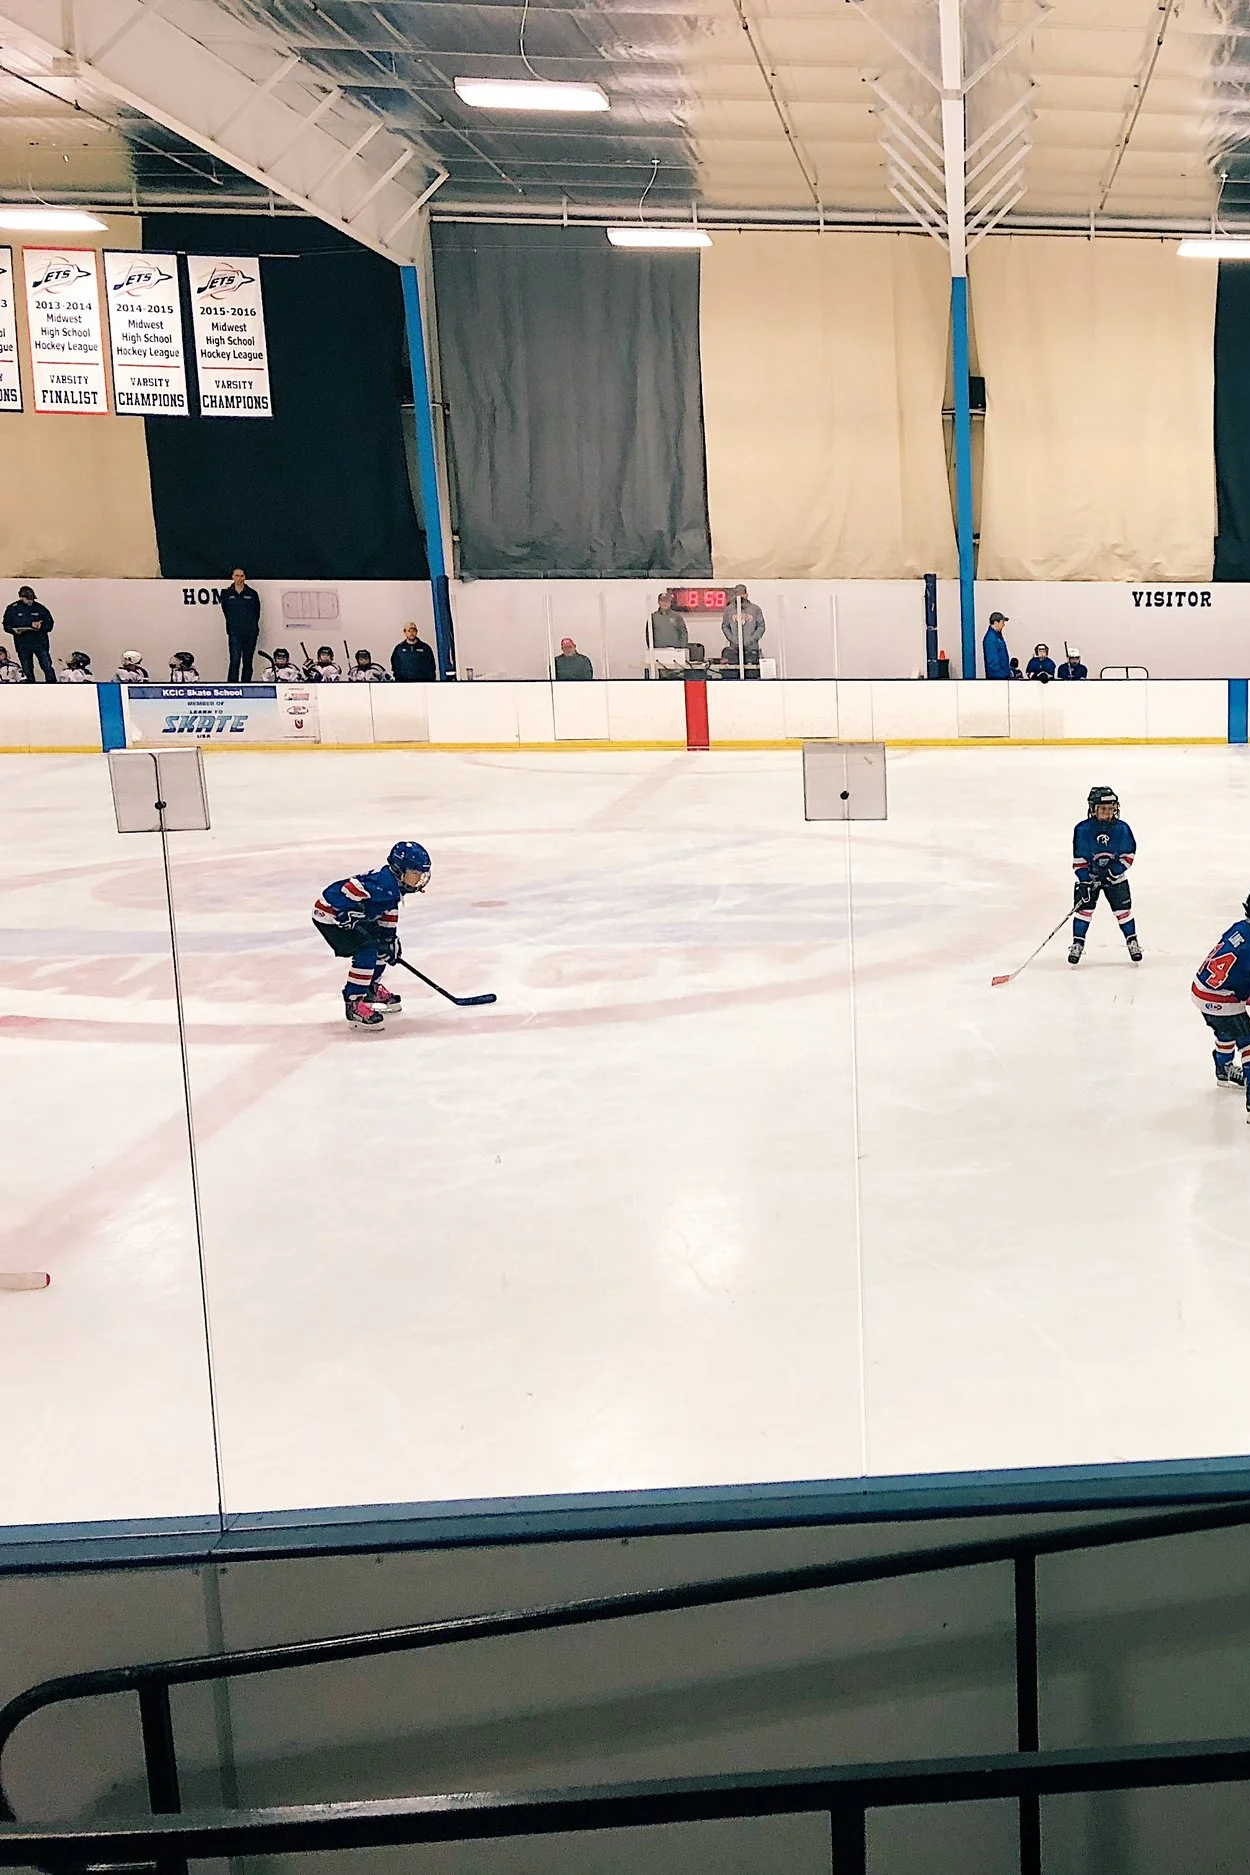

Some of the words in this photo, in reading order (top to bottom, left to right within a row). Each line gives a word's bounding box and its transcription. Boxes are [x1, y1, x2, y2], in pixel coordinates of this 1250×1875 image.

[35, 301, 92, 310] 2013-2014
[116, 304, 174, 314] 2014-2015
[200, 307, 257, 316] 2015-2016
[47, 313, 82, 323] Midwest
[128, 319, 164, 330] Midwest
[212, 322, 247, 332] Midwest
[41, 327, 60, 338] High
[62, 328, 91, 337] School
[122, 333, 142, 344] High
[144, 334, 172, 343] School
[206, 336, 225, 347] High
[227, 336, 255, 346] School
[35, 340, 65, 352] Hockey
[68, 342, 98, 353] League
[117, 347, 147, 358] Hockey
[149, 347, 180, 359] League
[200, 349, 231, 361] Hockey
[233, 350, 264, 361] League
[50, 375, 89, 384] VARSITY
[130, 377, 170, 387] VARSITY
[215, 380, 253, 389] VARSITY
[41, 390, 98, 404] FINALIST
[118, 392, 184, 407] CHAMPIONS
[202, 395, 268, 409] CHAMPIONS
[182, 588, 221, 605] HOM
[1132, 591, 1212, 607] VISITOR
[162, 715, 248, 733] SKATE
